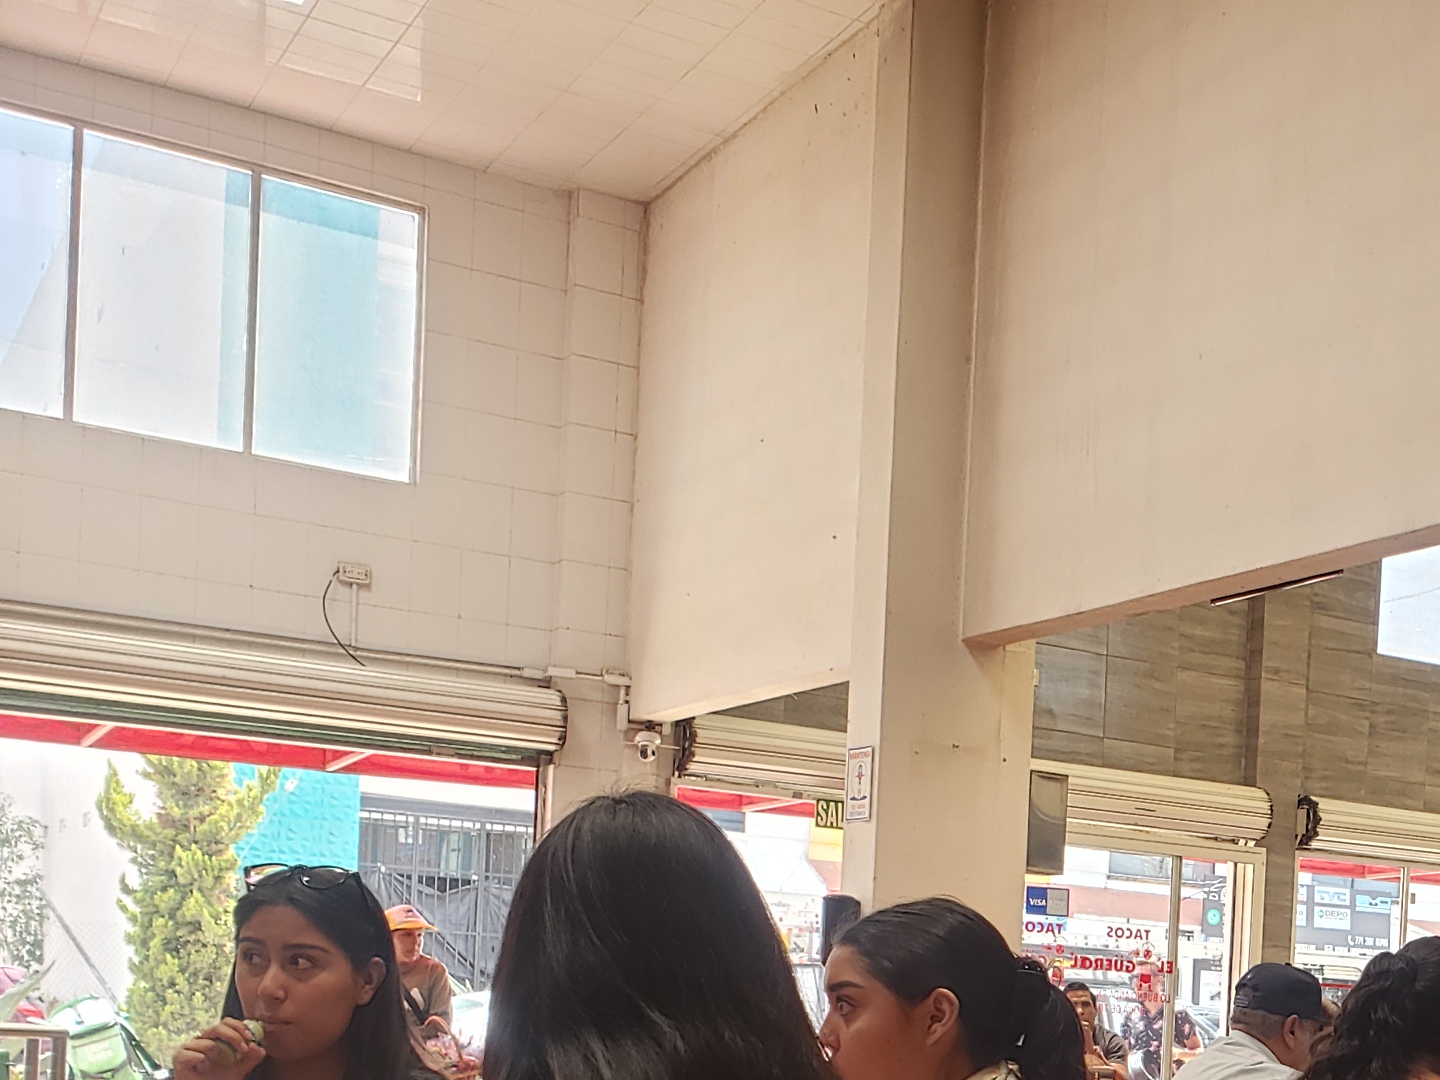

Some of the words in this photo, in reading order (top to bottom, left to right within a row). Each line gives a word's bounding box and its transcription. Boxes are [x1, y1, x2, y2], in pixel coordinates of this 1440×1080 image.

[817, 800, 844, 828] SAL
[1029, 898, 1047, 906] VISA
[1325, 910, 1348, 918] DEPO
